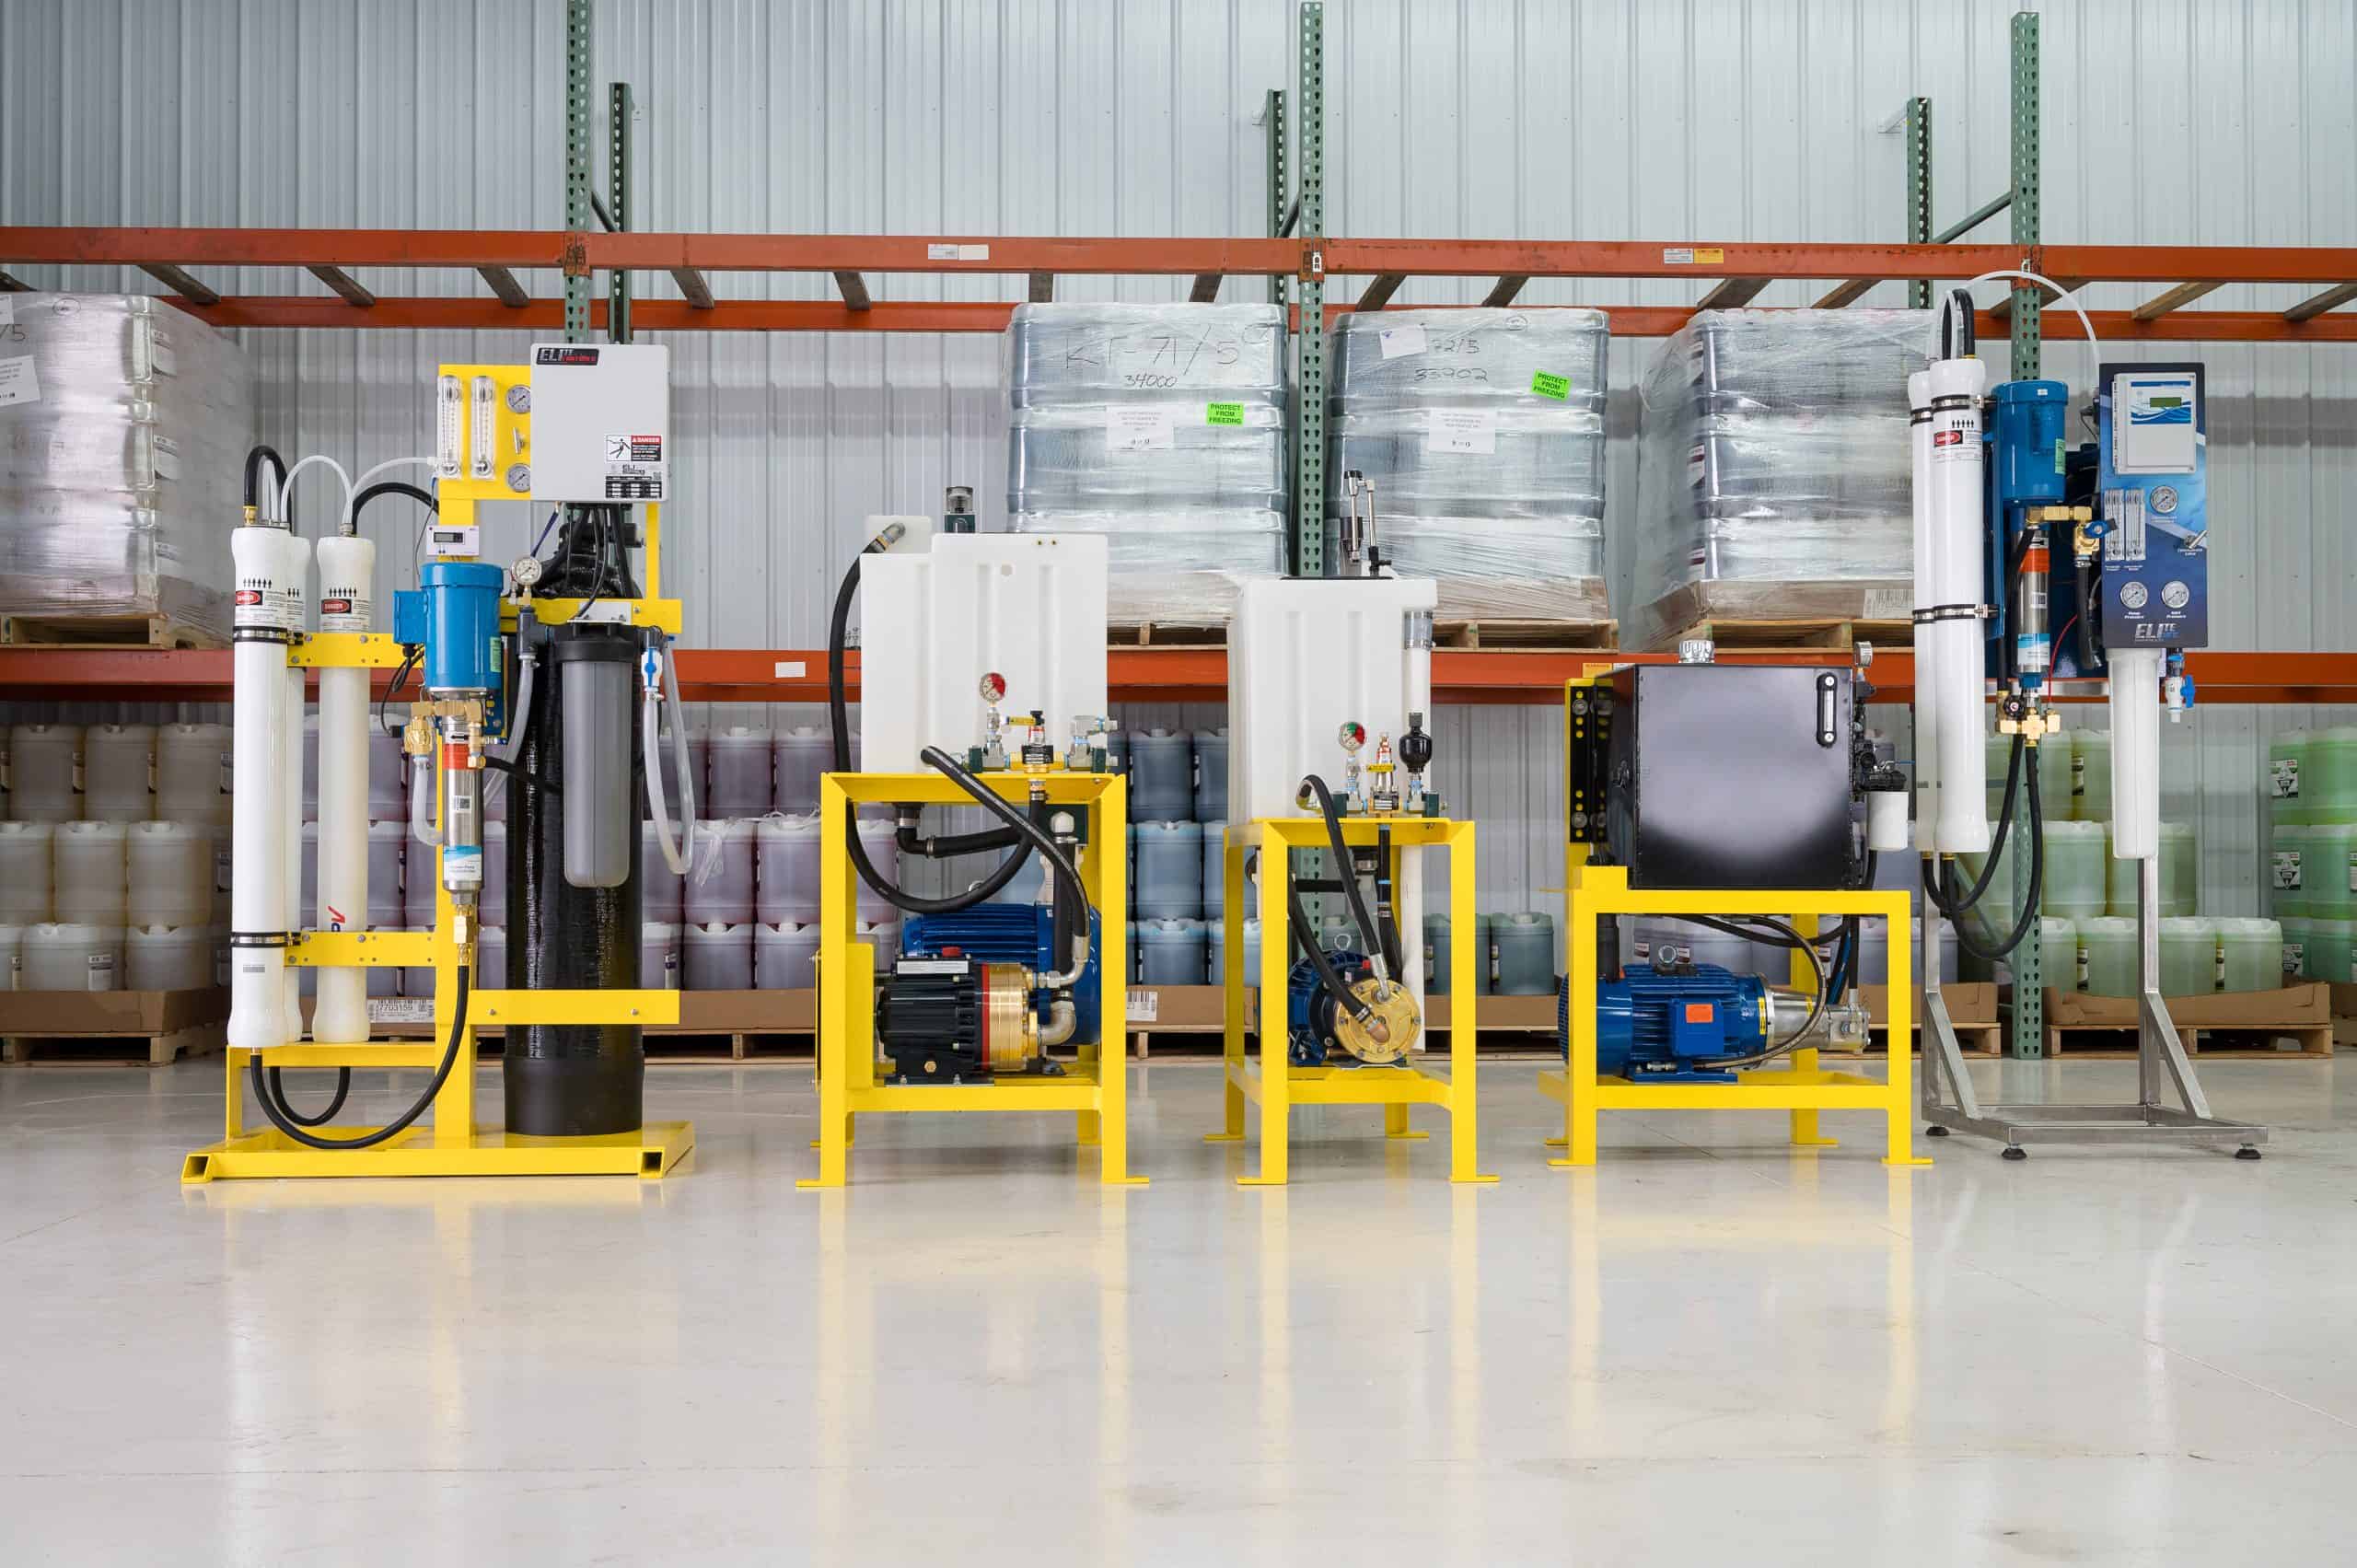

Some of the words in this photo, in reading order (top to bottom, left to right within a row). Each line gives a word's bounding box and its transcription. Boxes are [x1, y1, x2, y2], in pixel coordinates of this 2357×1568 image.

[1124, 374, 1178, 389] 34000
[1538, 372, 1567, 385] PROTECT
[1542, 380, 1561, 390] FROM
[1533, 386, 1565, 399] FREEZING
